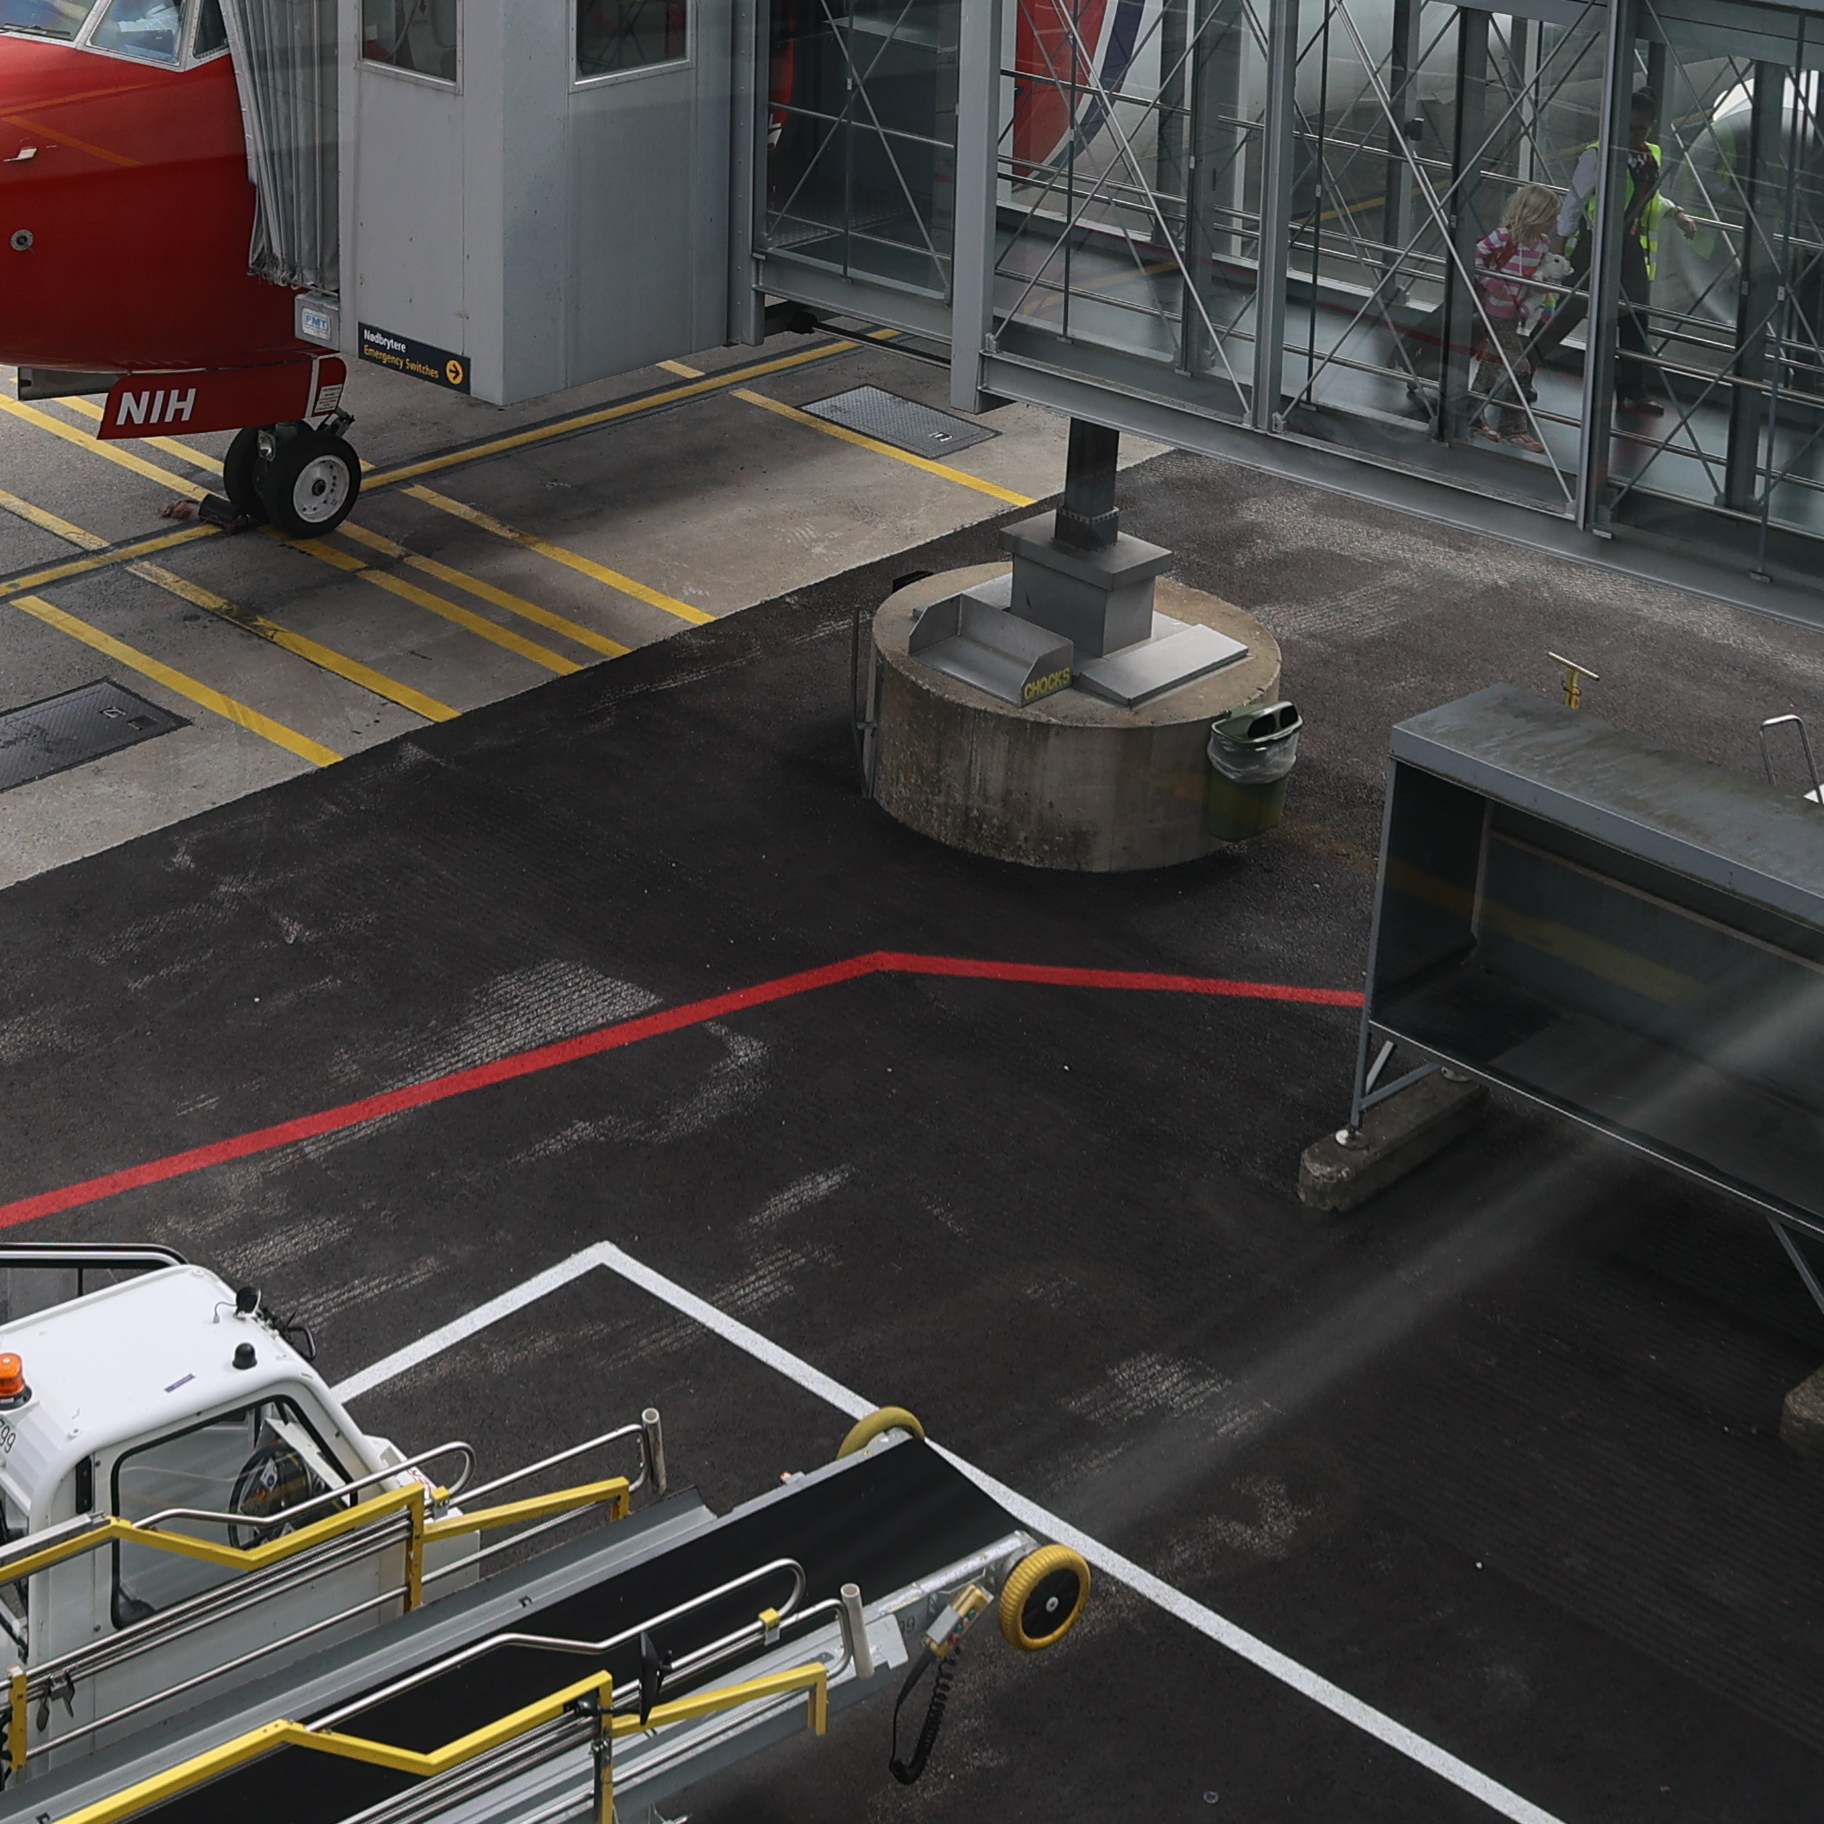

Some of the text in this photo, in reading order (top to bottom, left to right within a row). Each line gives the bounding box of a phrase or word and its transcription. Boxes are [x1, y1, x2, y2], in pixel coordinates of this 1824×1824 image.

[363, 328, 407, 353] Nødbrytere
[363, 344, 440, 378] Emergency Switches
[116, 387, 197, 426] NIH
[1024, 667, 1071, 700] CHOCKS
